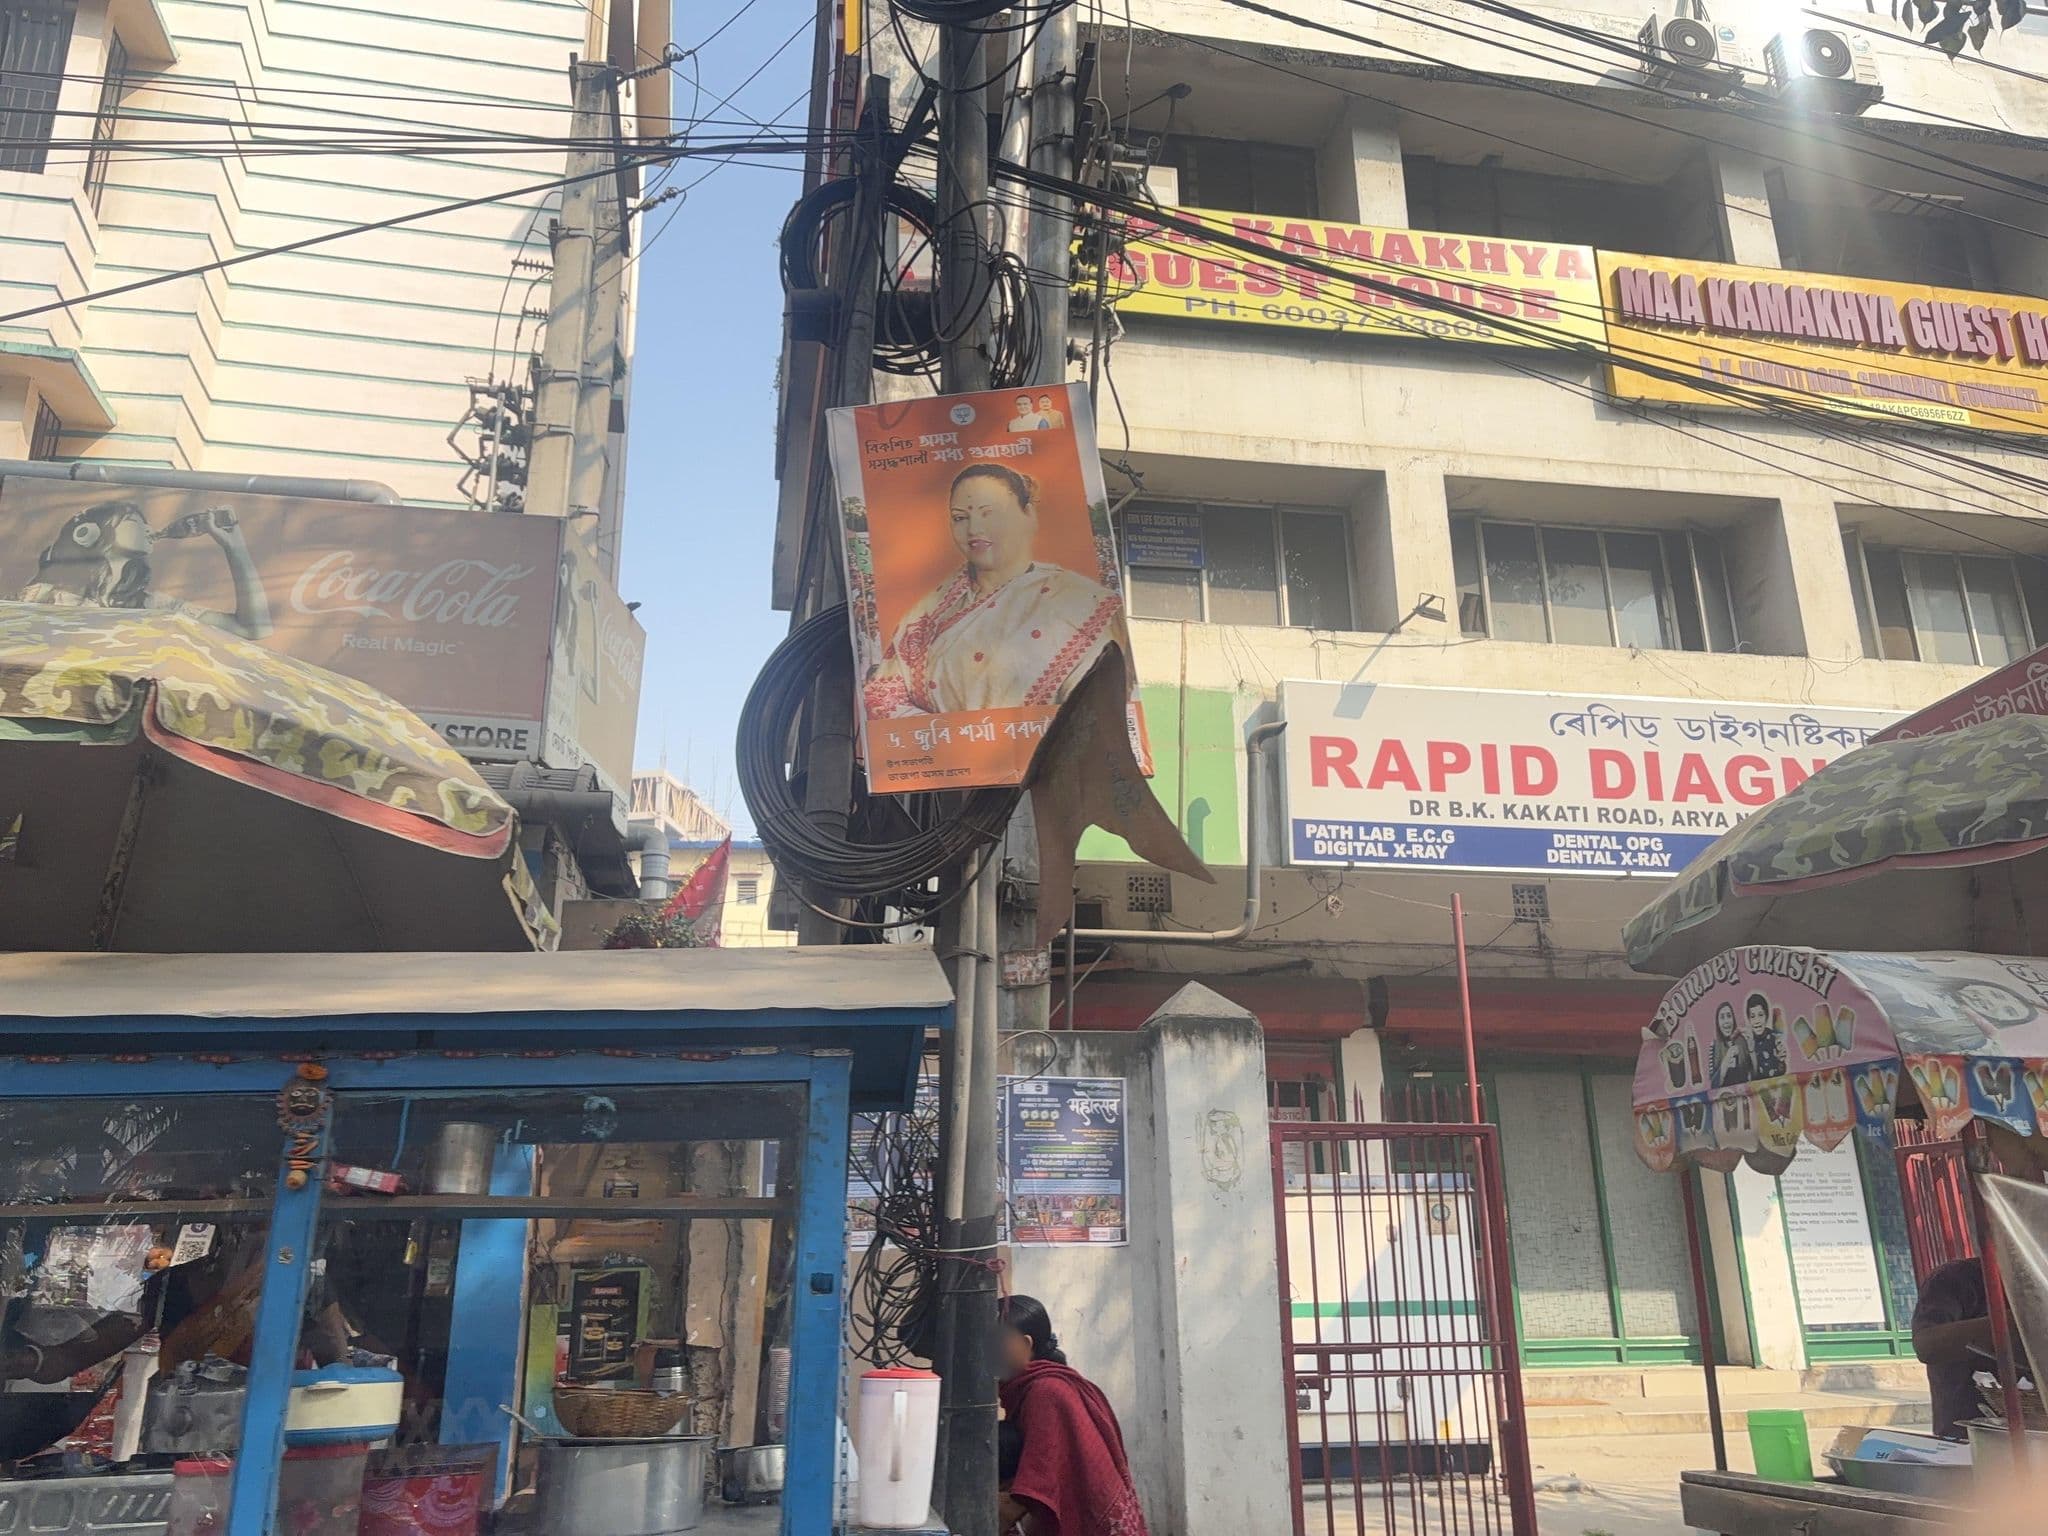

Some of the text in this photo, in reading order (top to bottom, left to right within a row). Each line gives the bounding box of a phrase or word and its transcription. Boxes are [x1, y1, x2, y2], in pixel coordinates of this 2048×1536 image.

[1232, 217, 1593, 281] KAMAKHYA
[1106, 249, 1561, 323] GUEST HOUSE
[1616, 266, 1705, 325] MAA
[1704, 277, 1907, 346] KAMAKHYA
[1908, 298, 2016, 357] GUEST
[343, 633, 457, 656] Real Magic
[445, 723, 529, 751] STORE
[1308, 734, 1559, 797] RAPID
[1409, 799, 1441, 817] DR
[1449, 801, 1495, 819] B.K.
[1503, 803, 1588, 823] KAKATI
[1597, 807, 1664, 827] ROAD,
[1671, 810, 1730, 828] ARYA
[1305, 823, 1455, 844] PATH LAB E.C.G
[1552, 834, 1664, 852] DENTAL OPG
[1313, 840, 1448, 860] DIGITAL X-RAY
[1546, 849, 1672, 868] DENTAL X-RAY
[1066, 1089, 1120, 1126] महोत्सव
